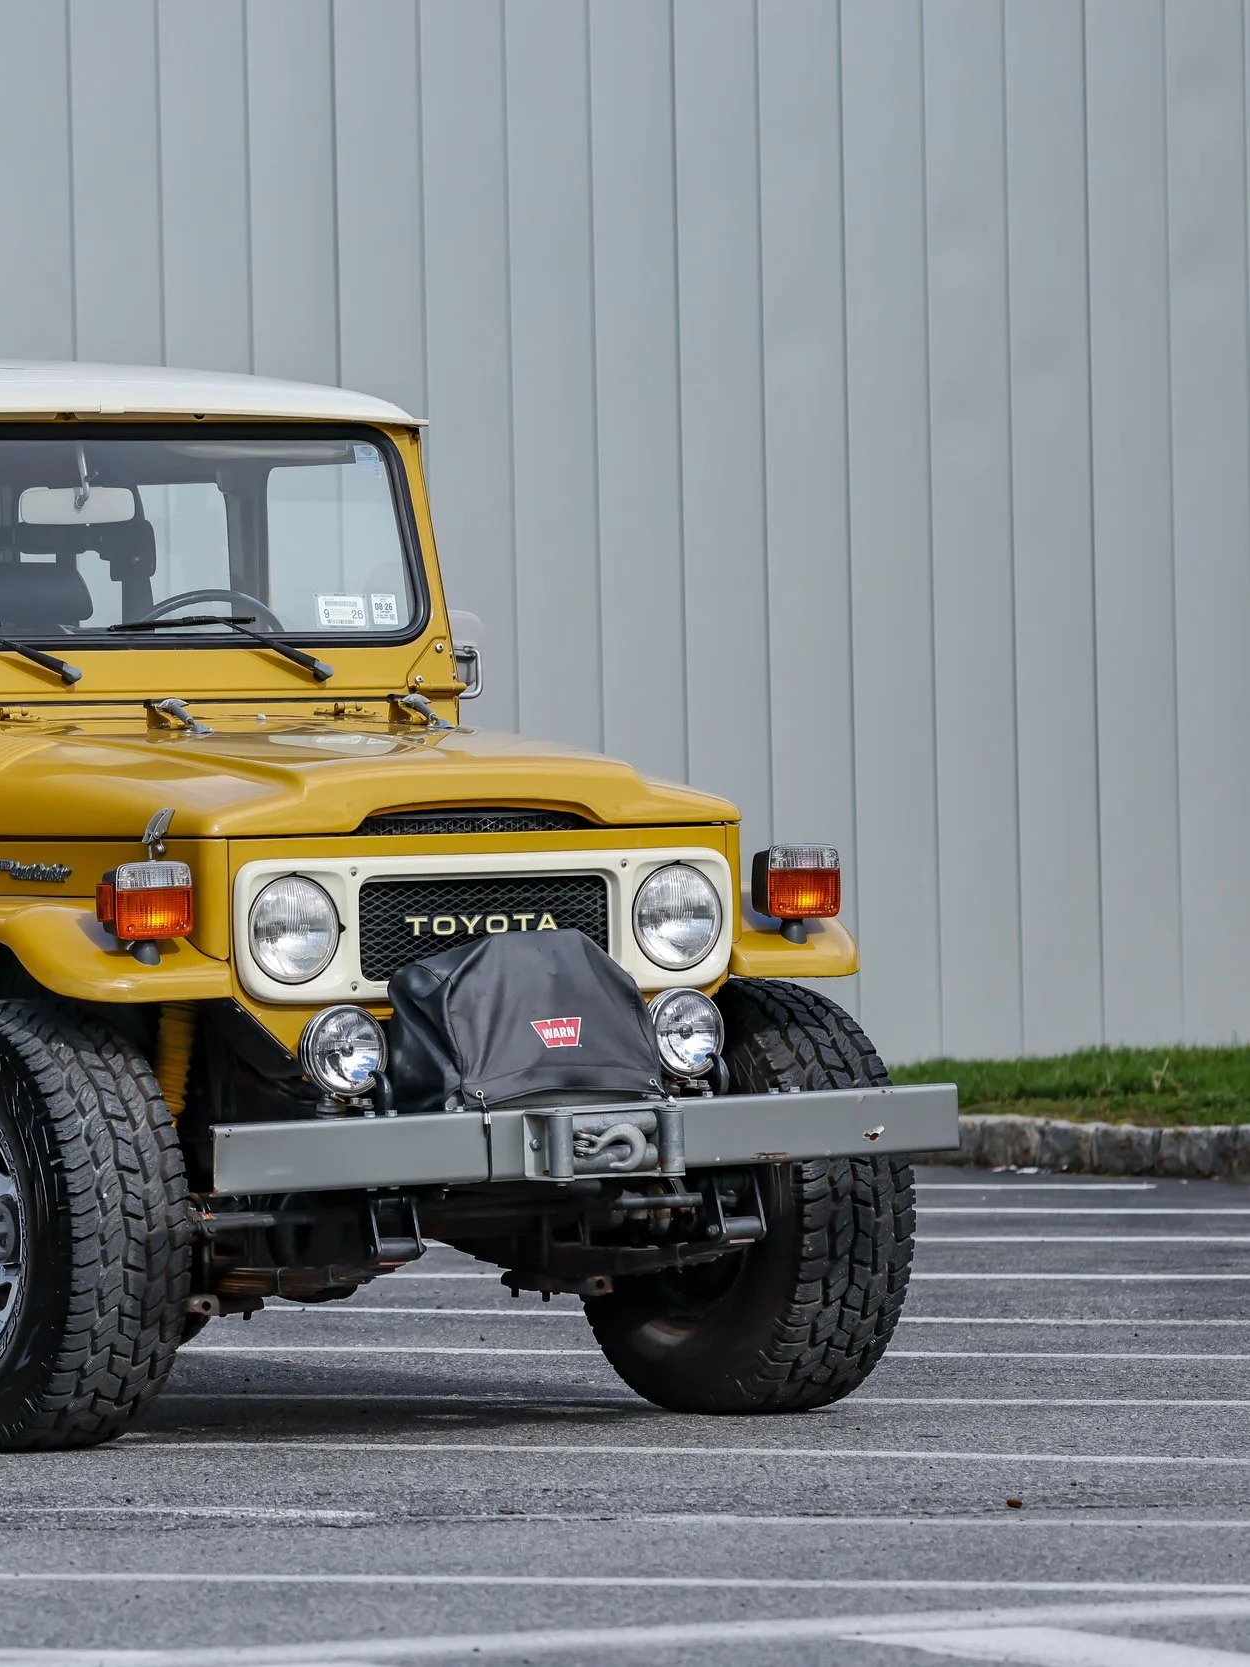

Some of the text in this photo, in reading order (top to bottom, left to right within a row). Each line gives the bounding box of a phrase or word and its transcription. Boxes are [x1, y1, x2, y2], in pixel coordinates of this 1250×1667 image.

[351, 609, 364, 619] 26
[405, 912, 559, 937] TOYOTA
[541, 1026, 576, 1039] WARN
